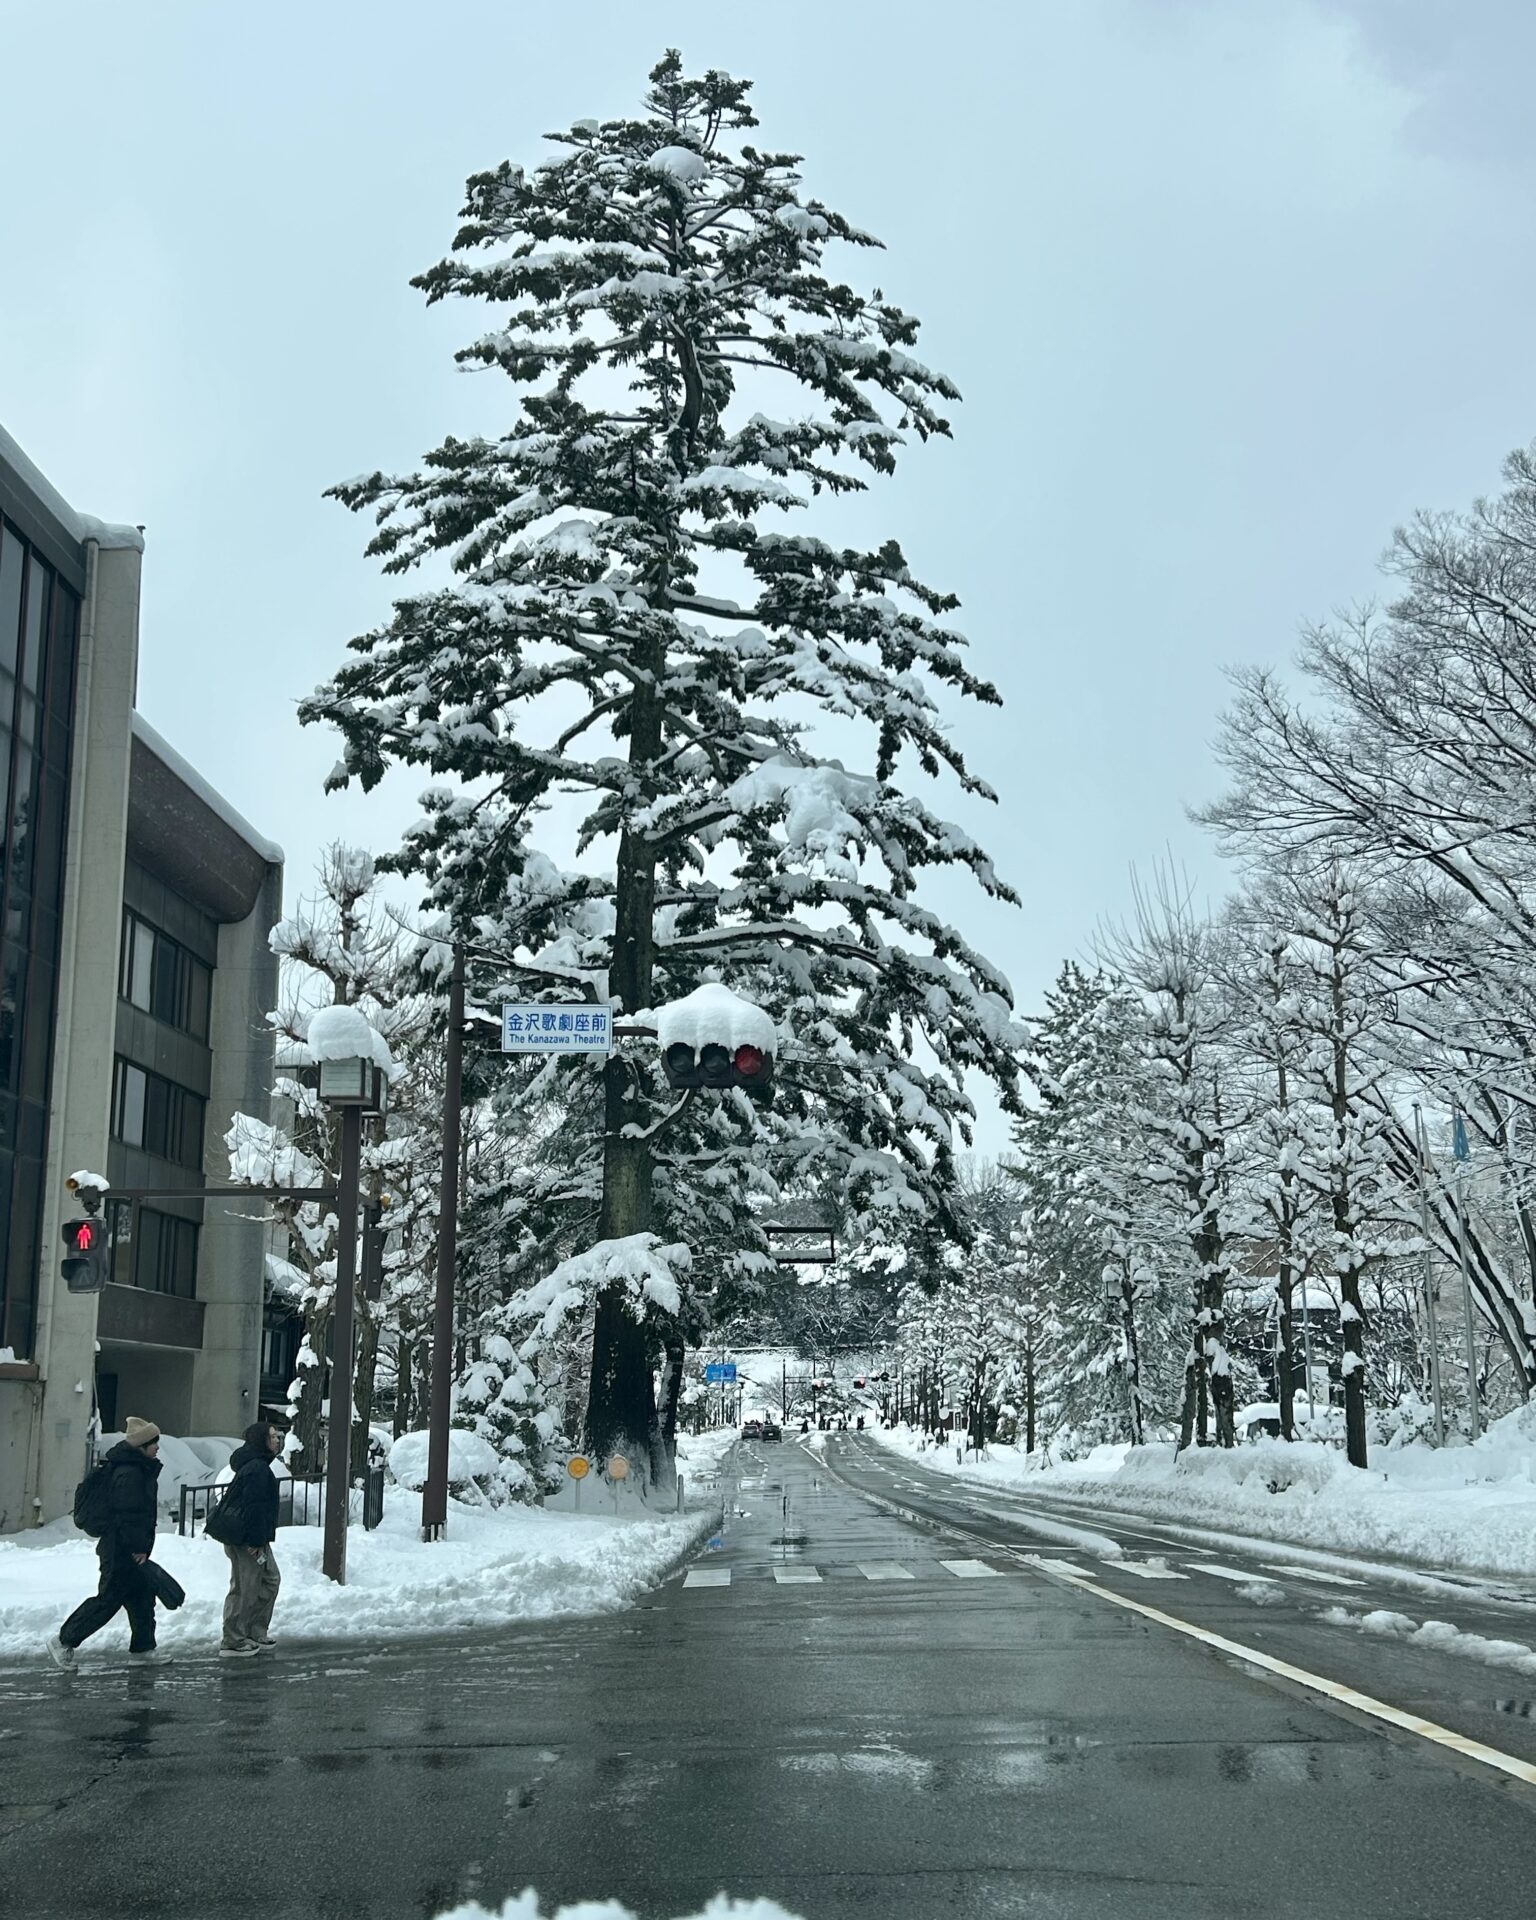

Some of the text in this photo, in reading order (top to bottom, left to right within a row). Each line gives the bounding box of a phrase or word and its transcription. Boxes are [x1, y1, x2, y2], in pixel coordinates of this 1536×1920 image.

[508, 1013, 606, 1031] 金沢歌劇座前
[509, 1034, 605, 1044] The Kanazawa Theatre
